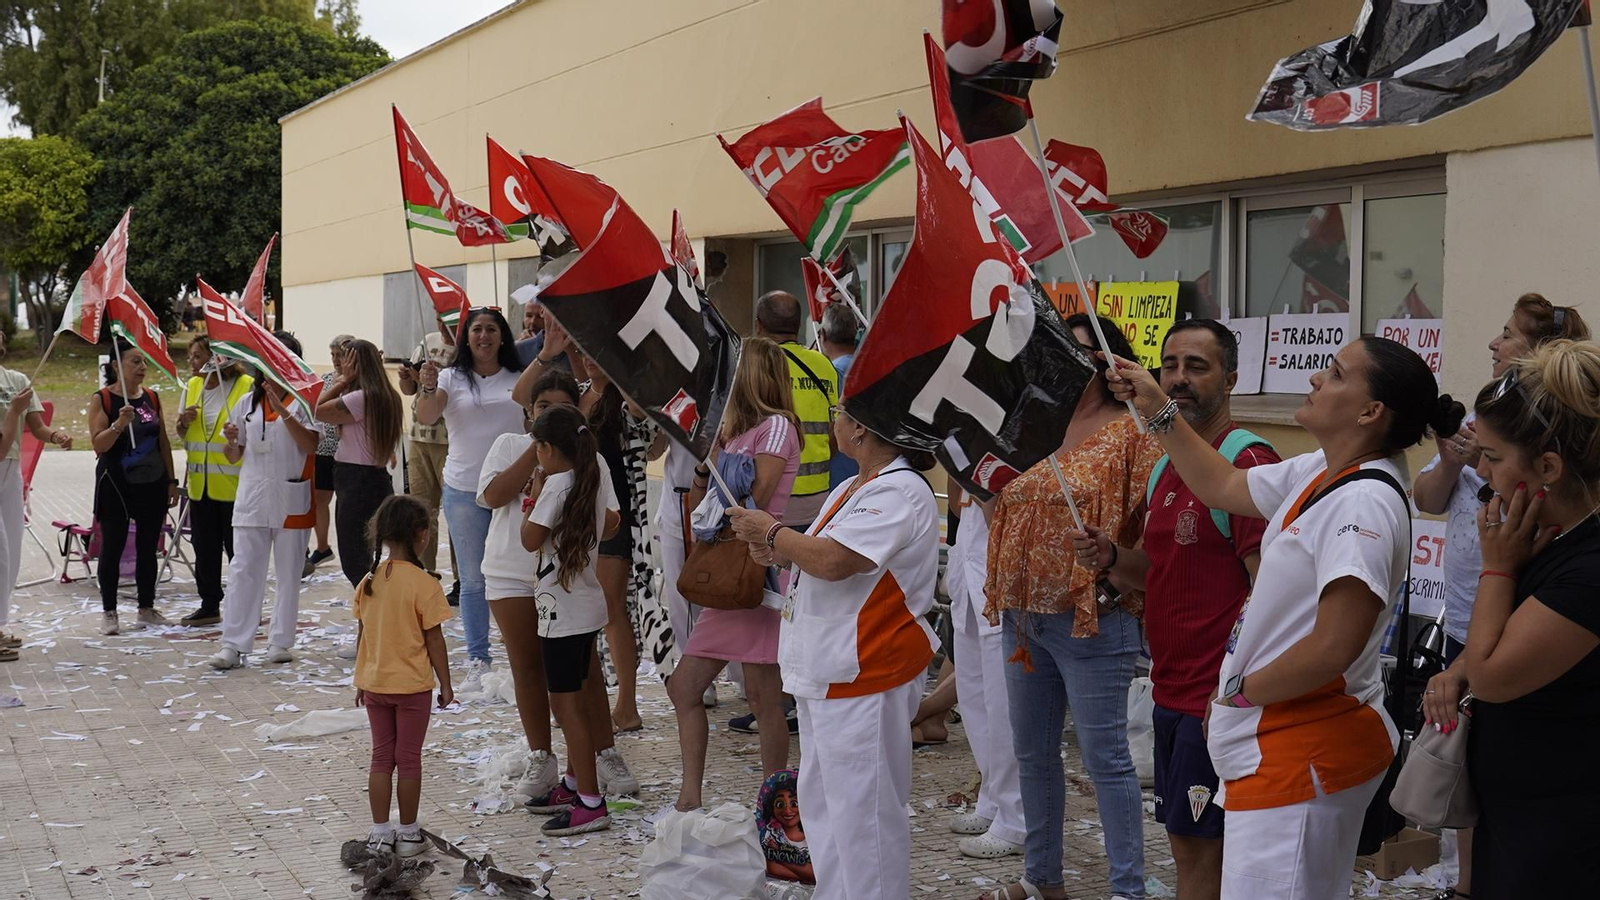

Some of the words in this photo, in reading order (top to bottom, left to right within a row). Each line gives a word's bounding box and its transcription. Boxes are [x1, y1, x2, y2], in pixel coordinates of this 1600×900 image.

[1059, 293, 1078, 314] UN
[1101, 294, 1123, 318] SIN
[1128, 294, 1172, 319] LIMPIEZA
[1143, 325, 1159, 346] SE
[1282, 327, 1343, 346] TRABAJO
[1418, 329, 1440, 348] UN
[1337, 523, 1360, 537] cero
